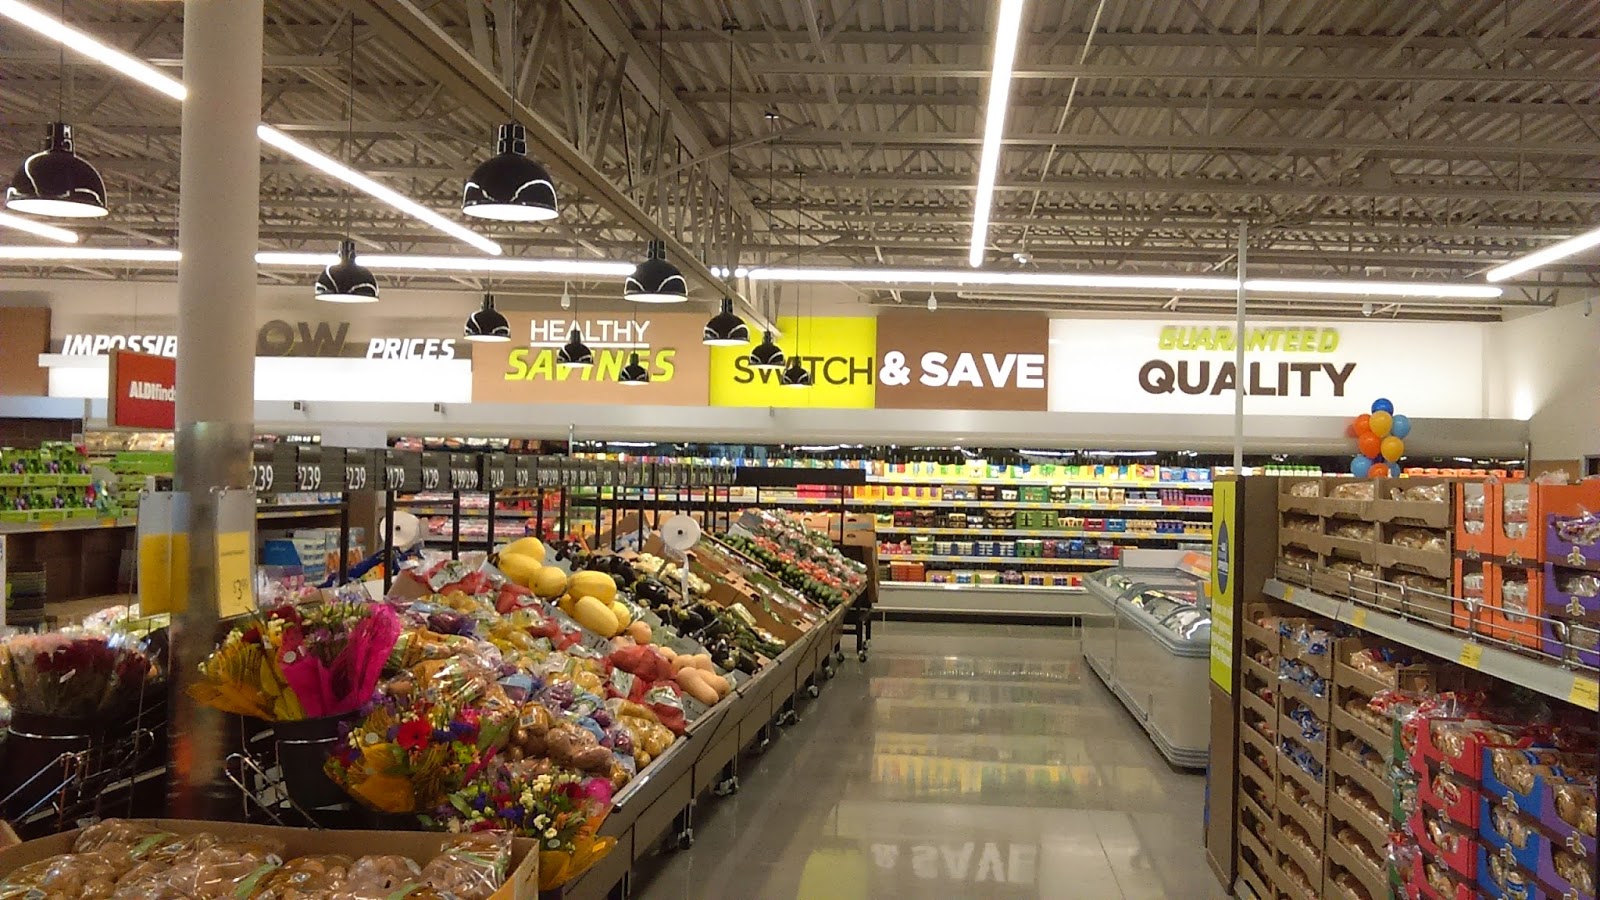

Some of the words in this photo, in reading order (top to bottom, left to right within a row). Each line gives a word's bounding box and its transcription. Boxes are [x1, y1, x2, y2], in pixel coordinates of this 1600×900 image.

[530, 319, 650, 342] HEALTHY
[1158, 325, 1339, 353] GUARANTEED
[366, 338, 455, 360] PRICES
[734, 355, 873, 385] STCH
[879, 350, 911, 386] &
[919, 351, 1045, 388] SAVE
[1138, 359, 1357, 397] QUALITY
